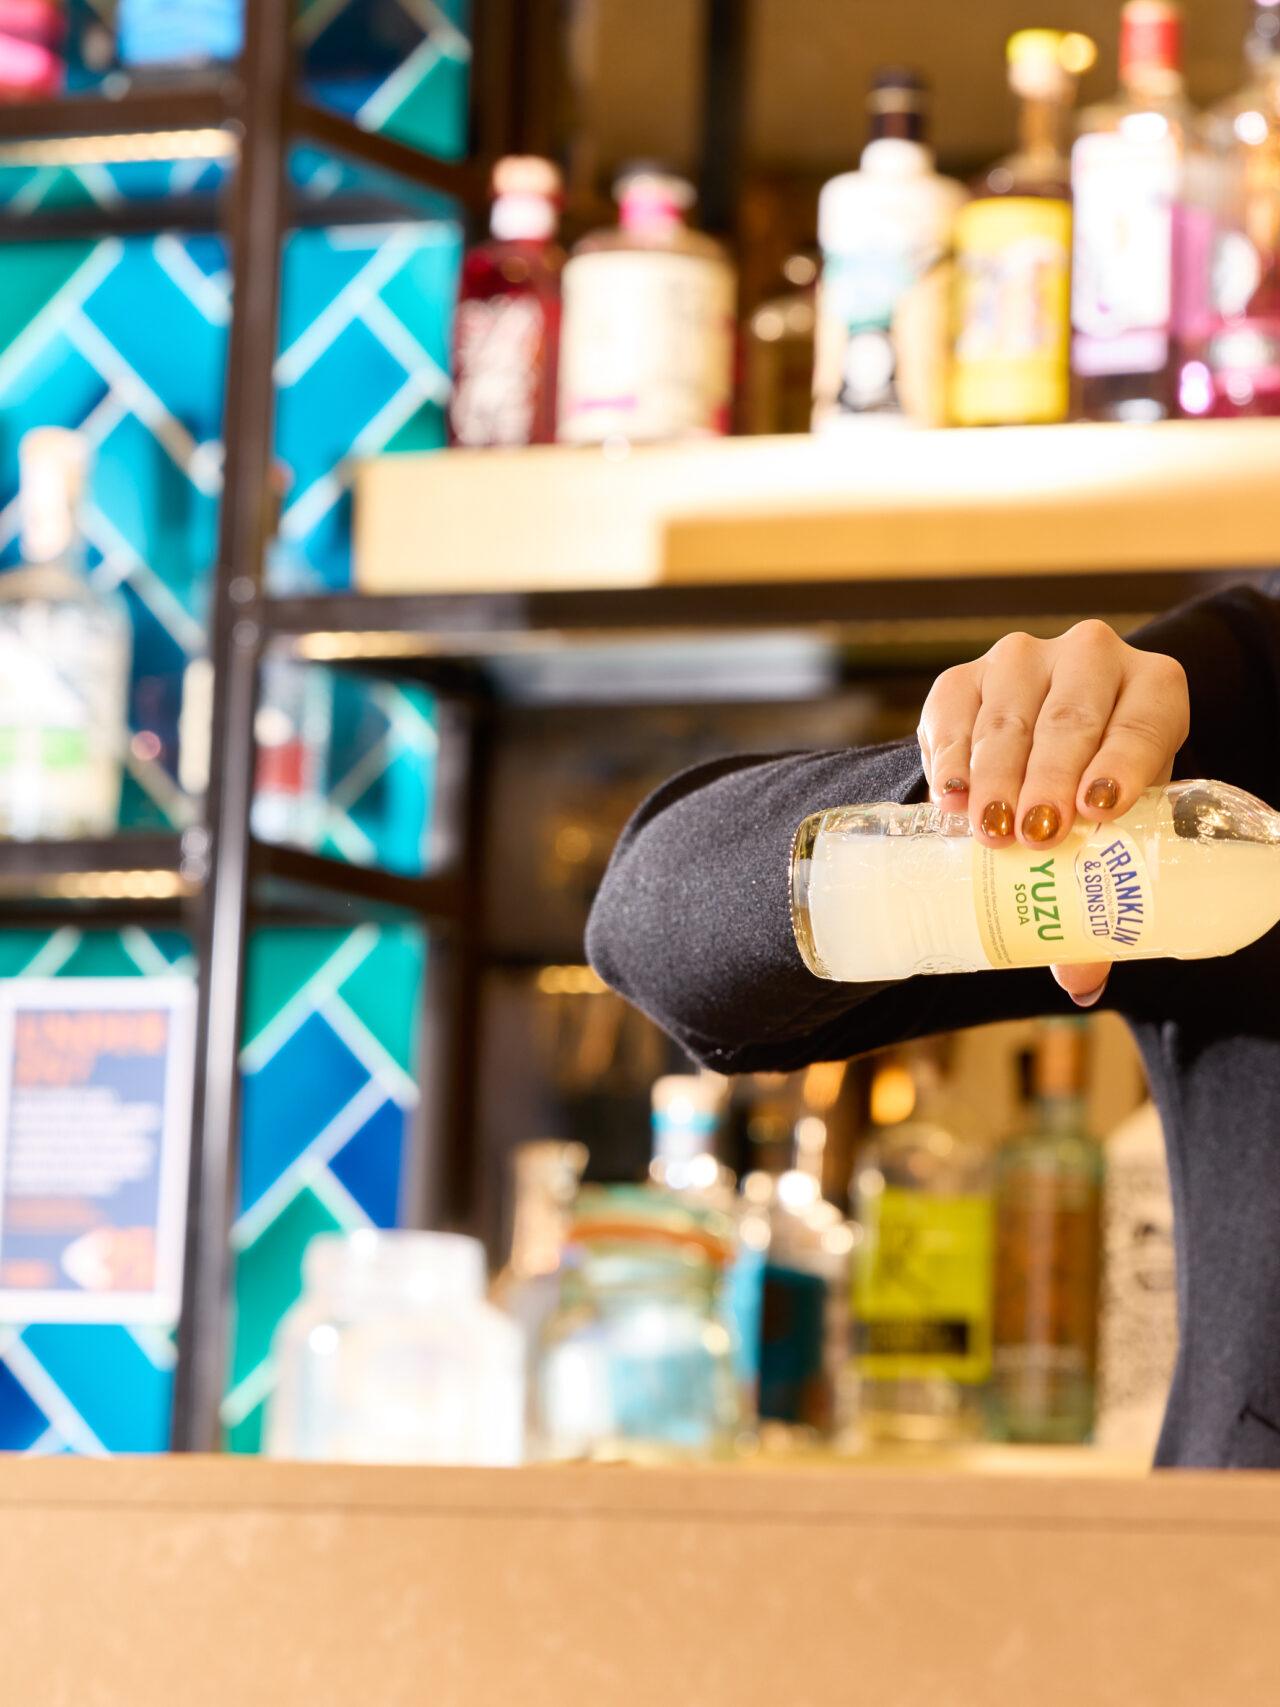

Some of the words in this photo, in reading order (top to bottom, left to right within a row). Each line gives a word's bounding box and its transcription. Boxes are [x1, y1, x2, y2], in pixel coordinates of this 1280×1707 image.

[1083, 860, 1102, 873] &
[1014, 883, 1030, 926] SODA
[1029, 857, 1065, 941] YUZU
[1084, 874, 1106, 913] SONS
[1100, 839, 1144, 946] FRANKLIN
[1089, 914, 1110, 937] LTD
